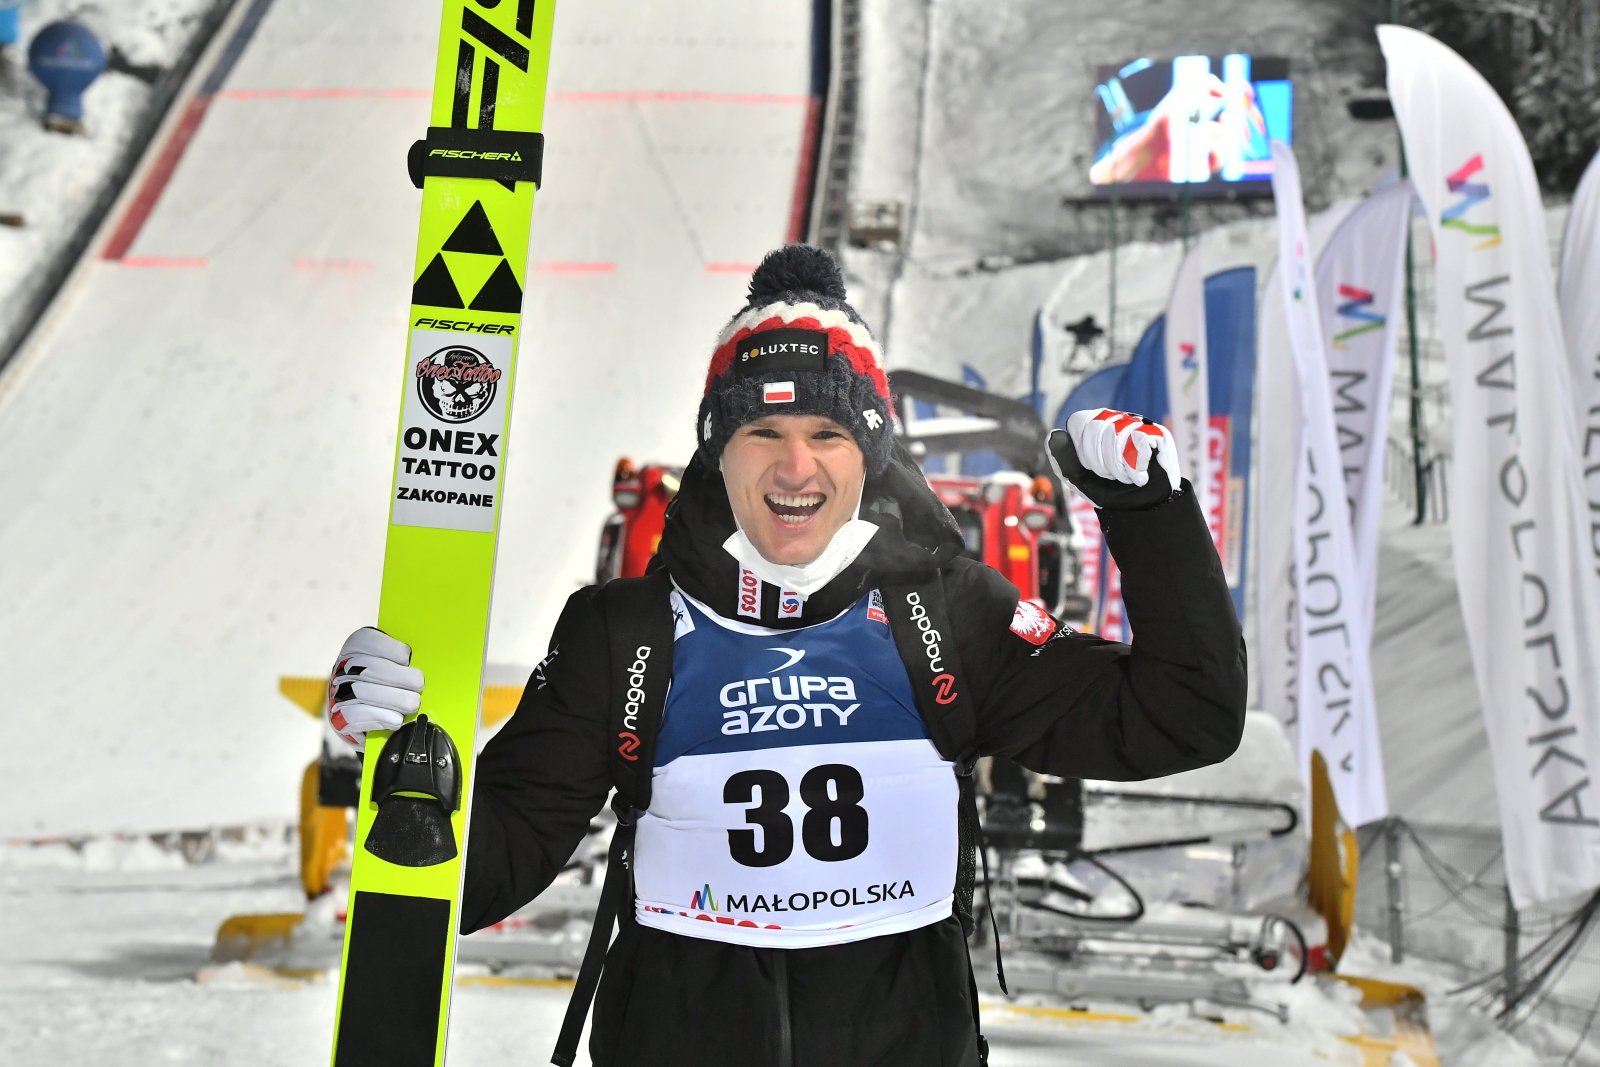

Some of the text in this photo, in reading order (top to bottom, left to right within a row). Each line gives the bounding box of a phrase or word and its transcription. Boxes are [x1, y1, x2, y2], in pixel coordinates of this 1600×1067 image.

[429, 149, 512, 162] FISCHER
[414, 318, 515, 335] FISCHER
[741, 343, 819, 362] SOLUXTEC
[403, 426, 500, 457] ONEX
[402, 457, 496, 481] TATTOO
[397, 486, 494, 508] ZAKOPANE
[906, 592, 944, 673] nagaba
[623, 645, 651, 730] nagaba
[722, 763, 869, 868] 38
[726, 880, 915, 913] MAŁOPOLSKA
